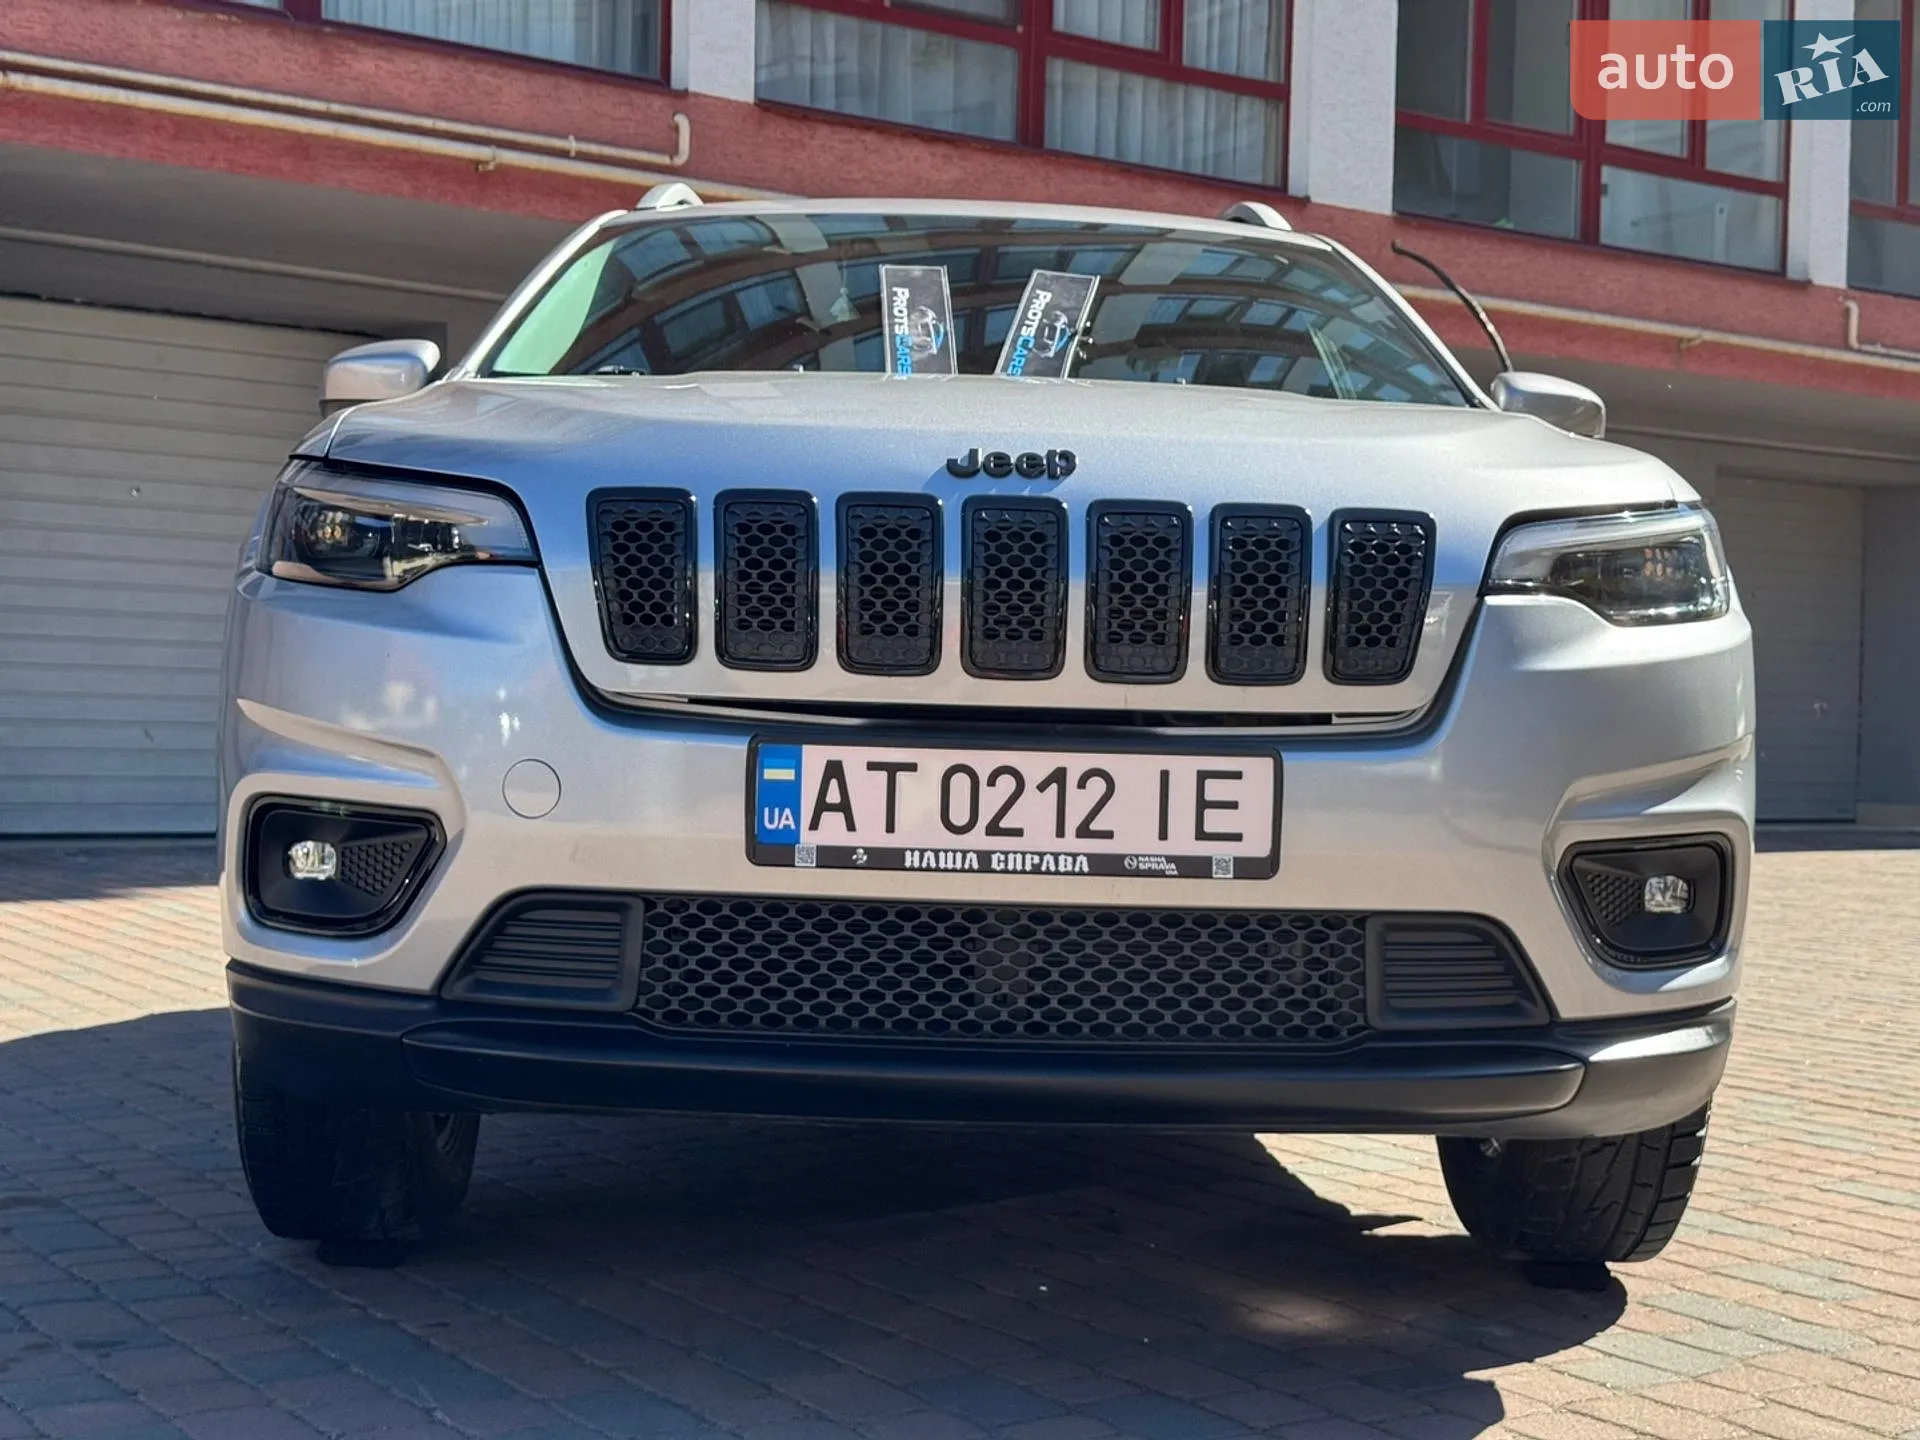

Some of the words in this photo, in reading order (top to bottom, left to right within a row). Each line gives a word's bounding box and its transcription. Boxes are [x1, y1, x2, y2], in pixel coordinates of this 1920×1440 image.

[946, 447, 1078, 481] Jeep
[808, 759, 918, 834] AT
[940, 763, 1115, 841] 0212
[1158, 769, 1244, 842] IE
[763, 806, 796, 830] UA
[904, 849, 979, 870] НАША
[990, 852, 1091, 873] СПРАВА
